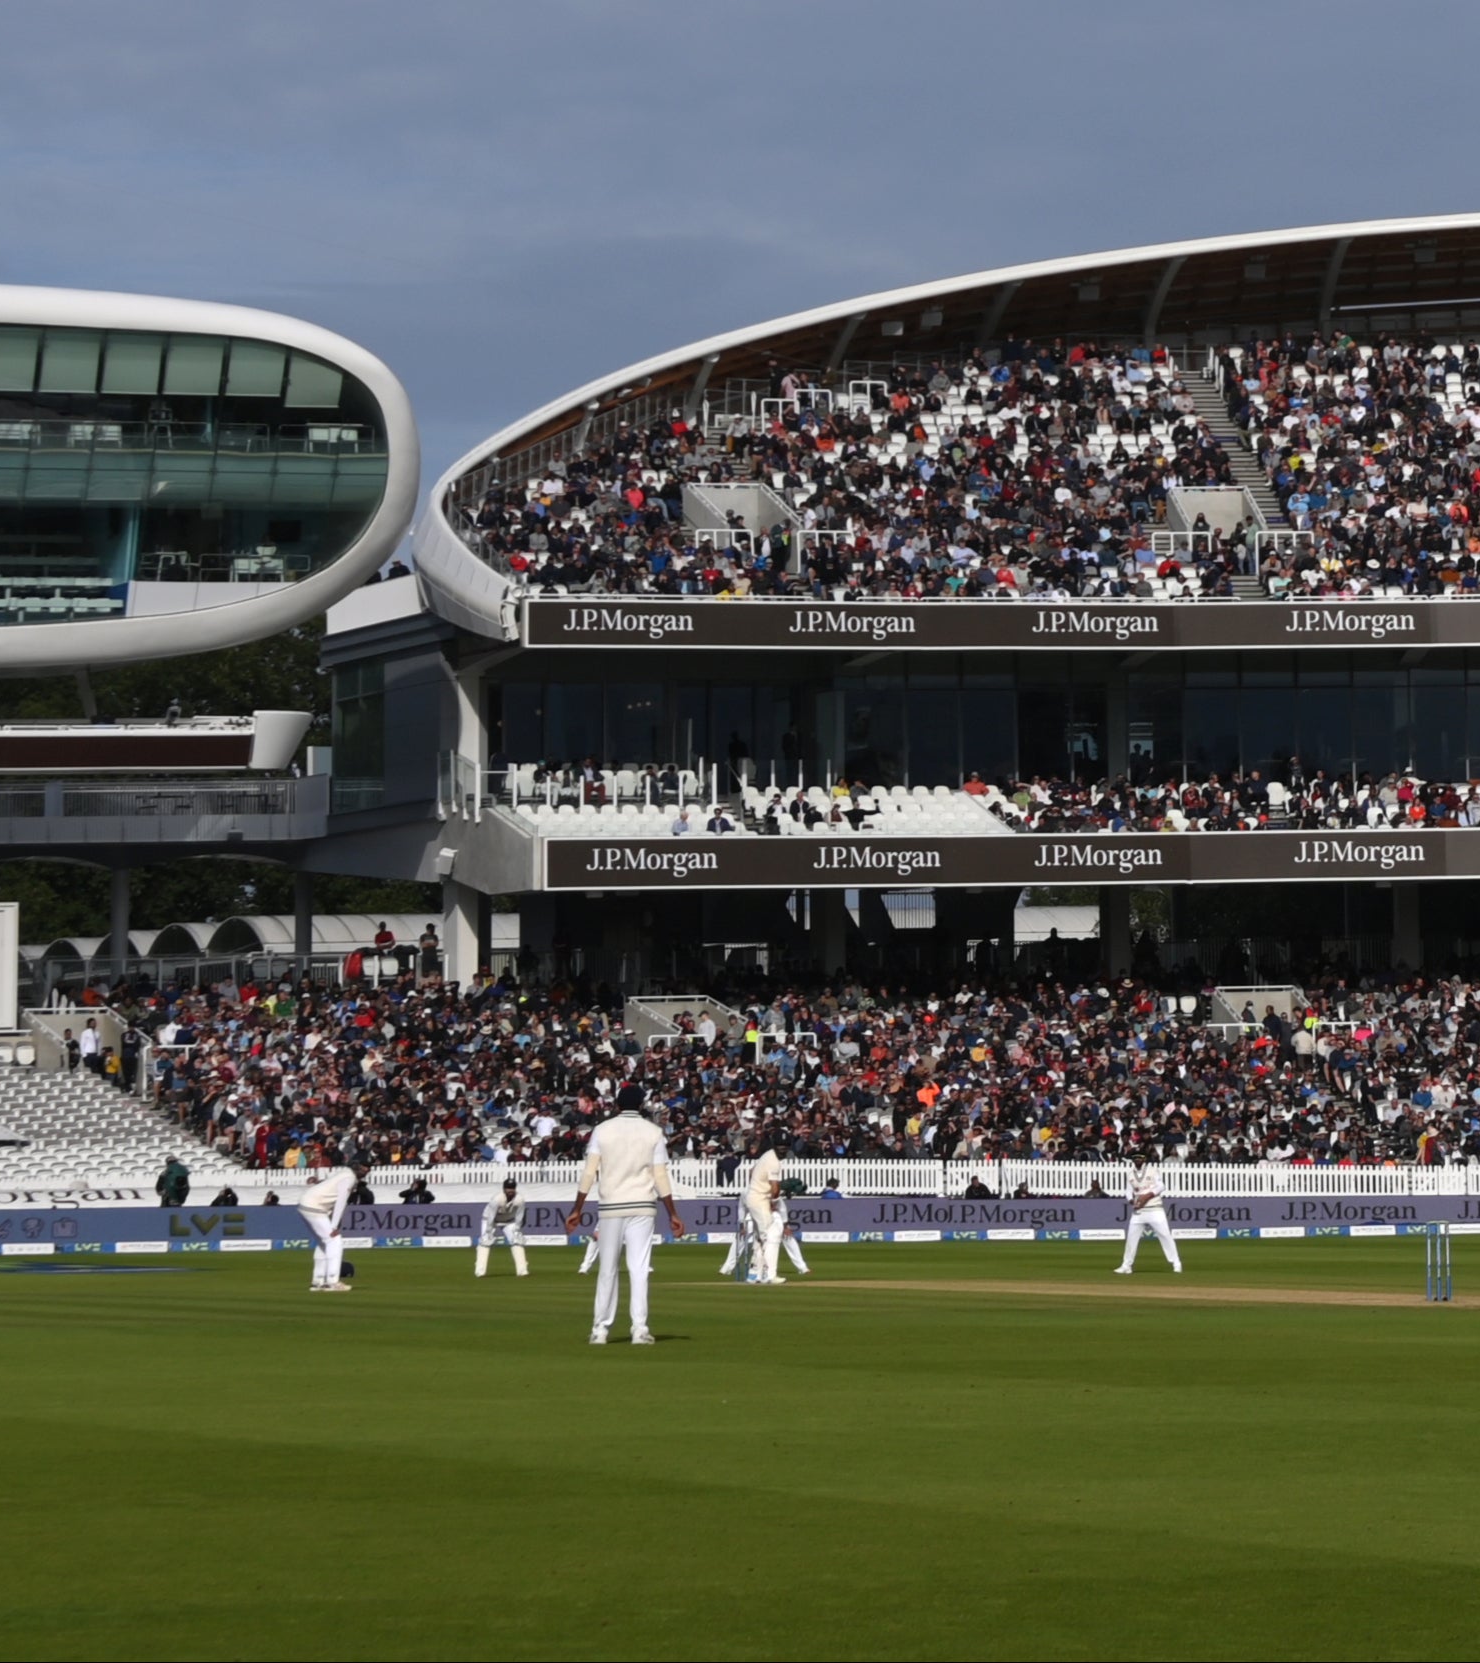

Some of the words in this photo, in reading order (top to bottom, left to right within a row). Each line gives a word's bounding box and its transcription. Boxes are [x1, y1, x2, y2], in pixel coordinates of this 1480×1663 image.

[562, 607, 694, 640] J.P.Morgan
[788, 609, 916, 642] J.P.Morgan
[1031, 610, 1159, 641] J.P.Morgan
[1285, 609, 1416, 639] J.P.Morgan
[585, 846, 719, 878] J.P.Morgan
[812, 845, 942, 876] J.P.Morgan
[1034, 844, 1163, 875] J.P.Morgan
[1293, 840, 1426, 870] J.P.Morgan
[341, 1209, 472, 1236] .P.Morgan
[1281, 1201, 1418, 1228] J.P.Morgan
